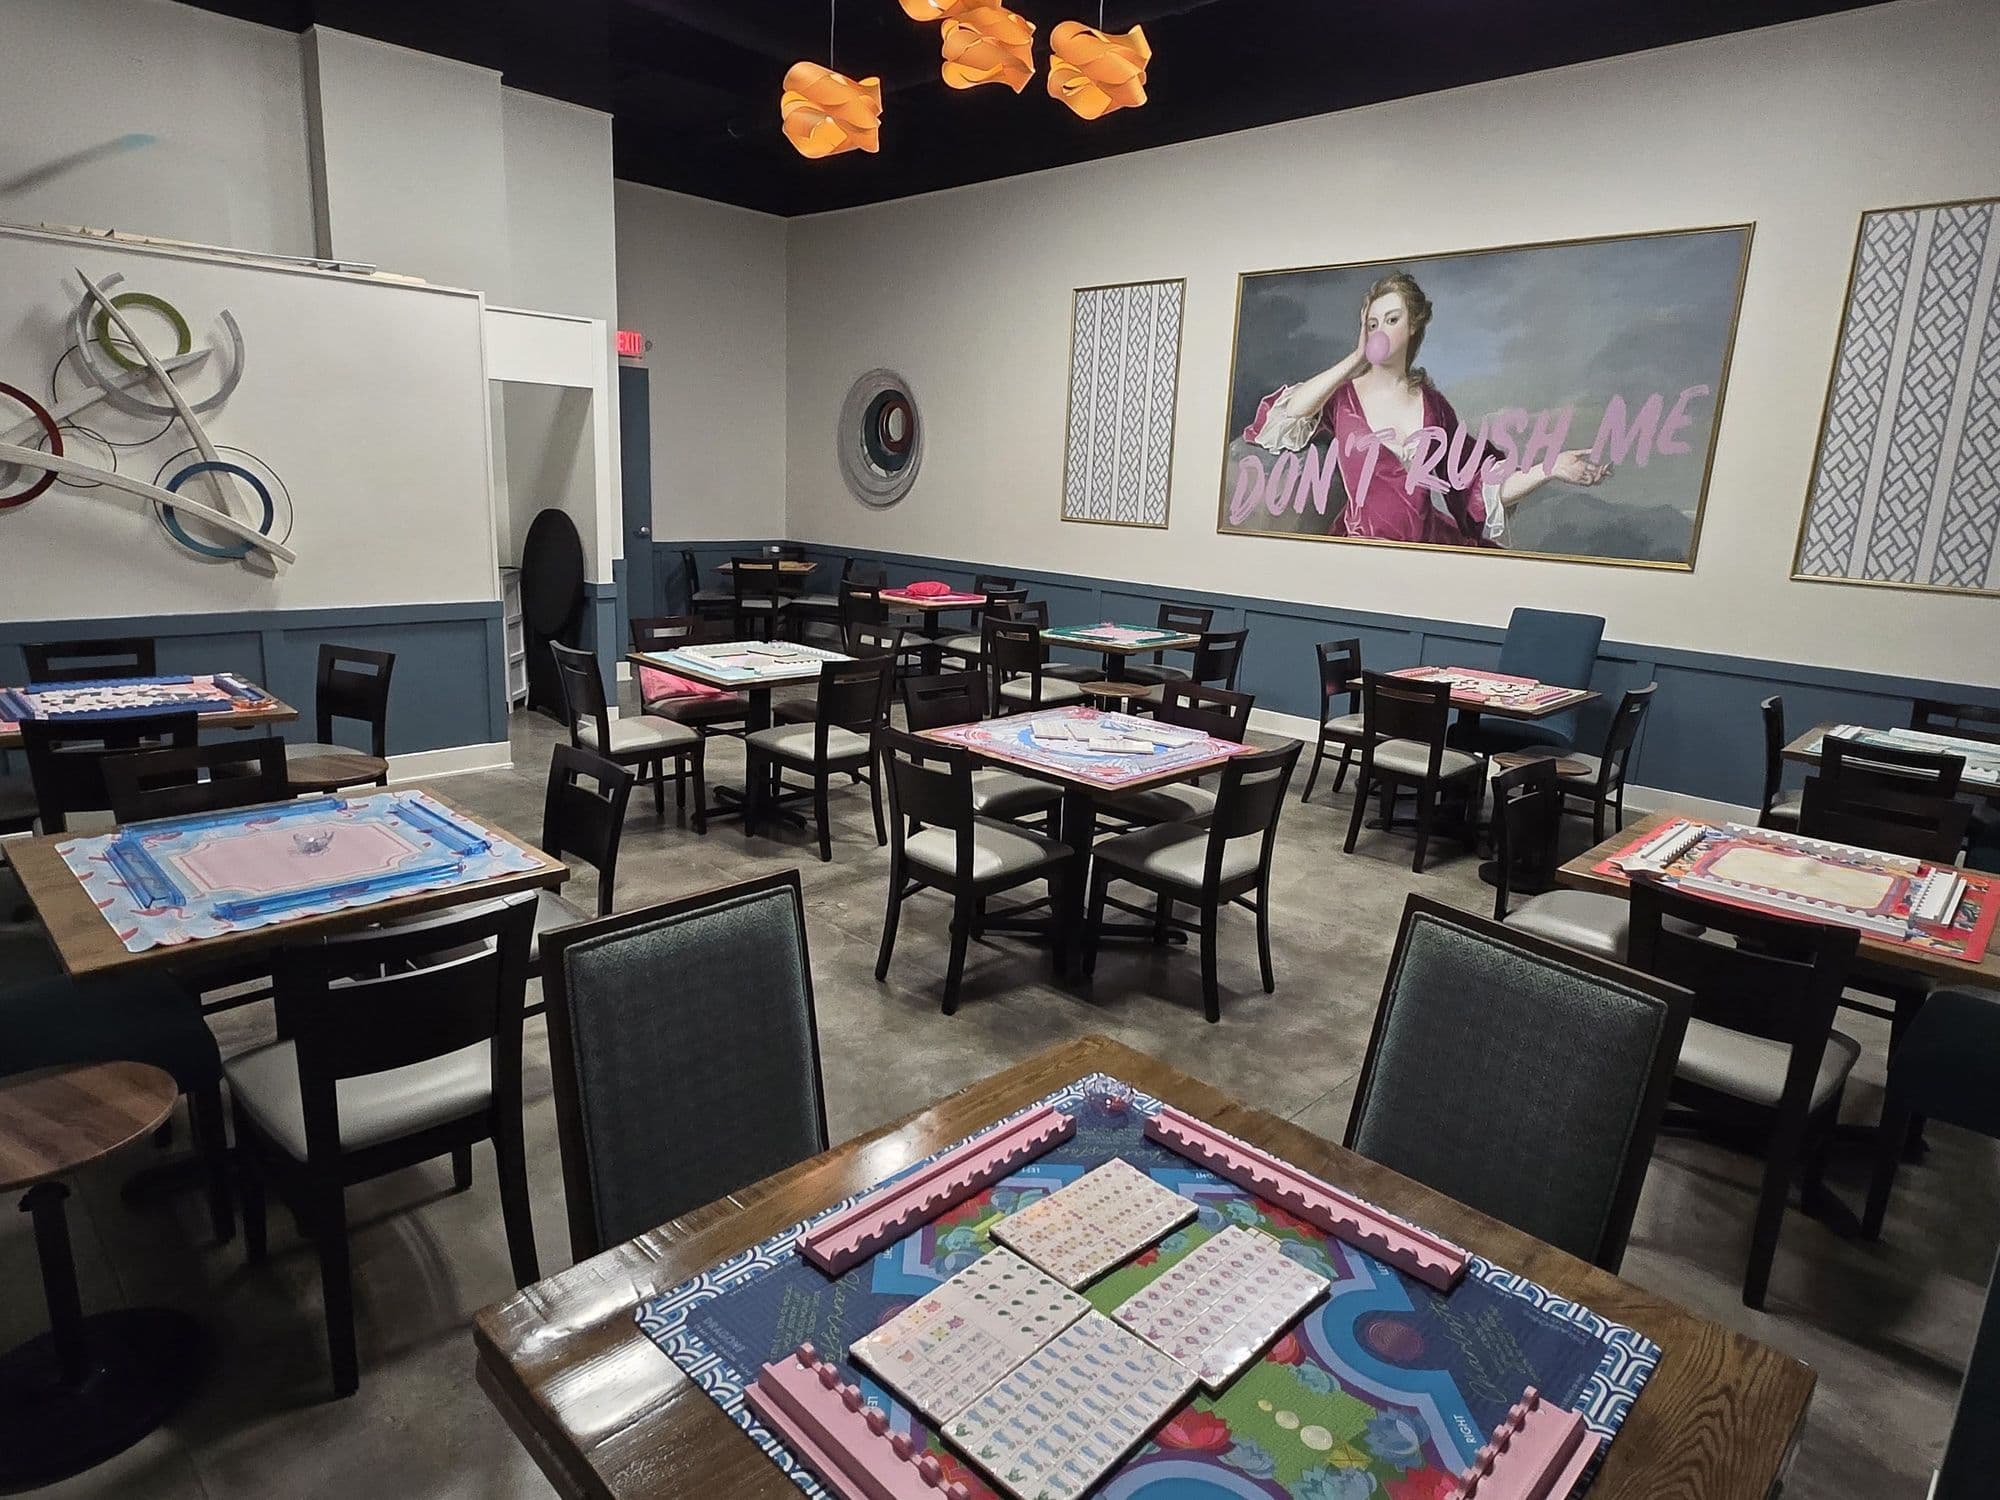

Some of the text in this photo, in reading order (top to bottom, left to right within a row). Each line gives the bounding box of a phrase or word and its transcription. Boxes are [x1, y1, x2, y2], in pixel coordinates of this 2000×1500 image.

[618, 331, 640, 353] EXIT
[1228, 384, 1710, 526] DON'T RUSH ME
[867, 1396, 879, 1407] LE
[1453, 1414, 1477, 1444] RIGHT
